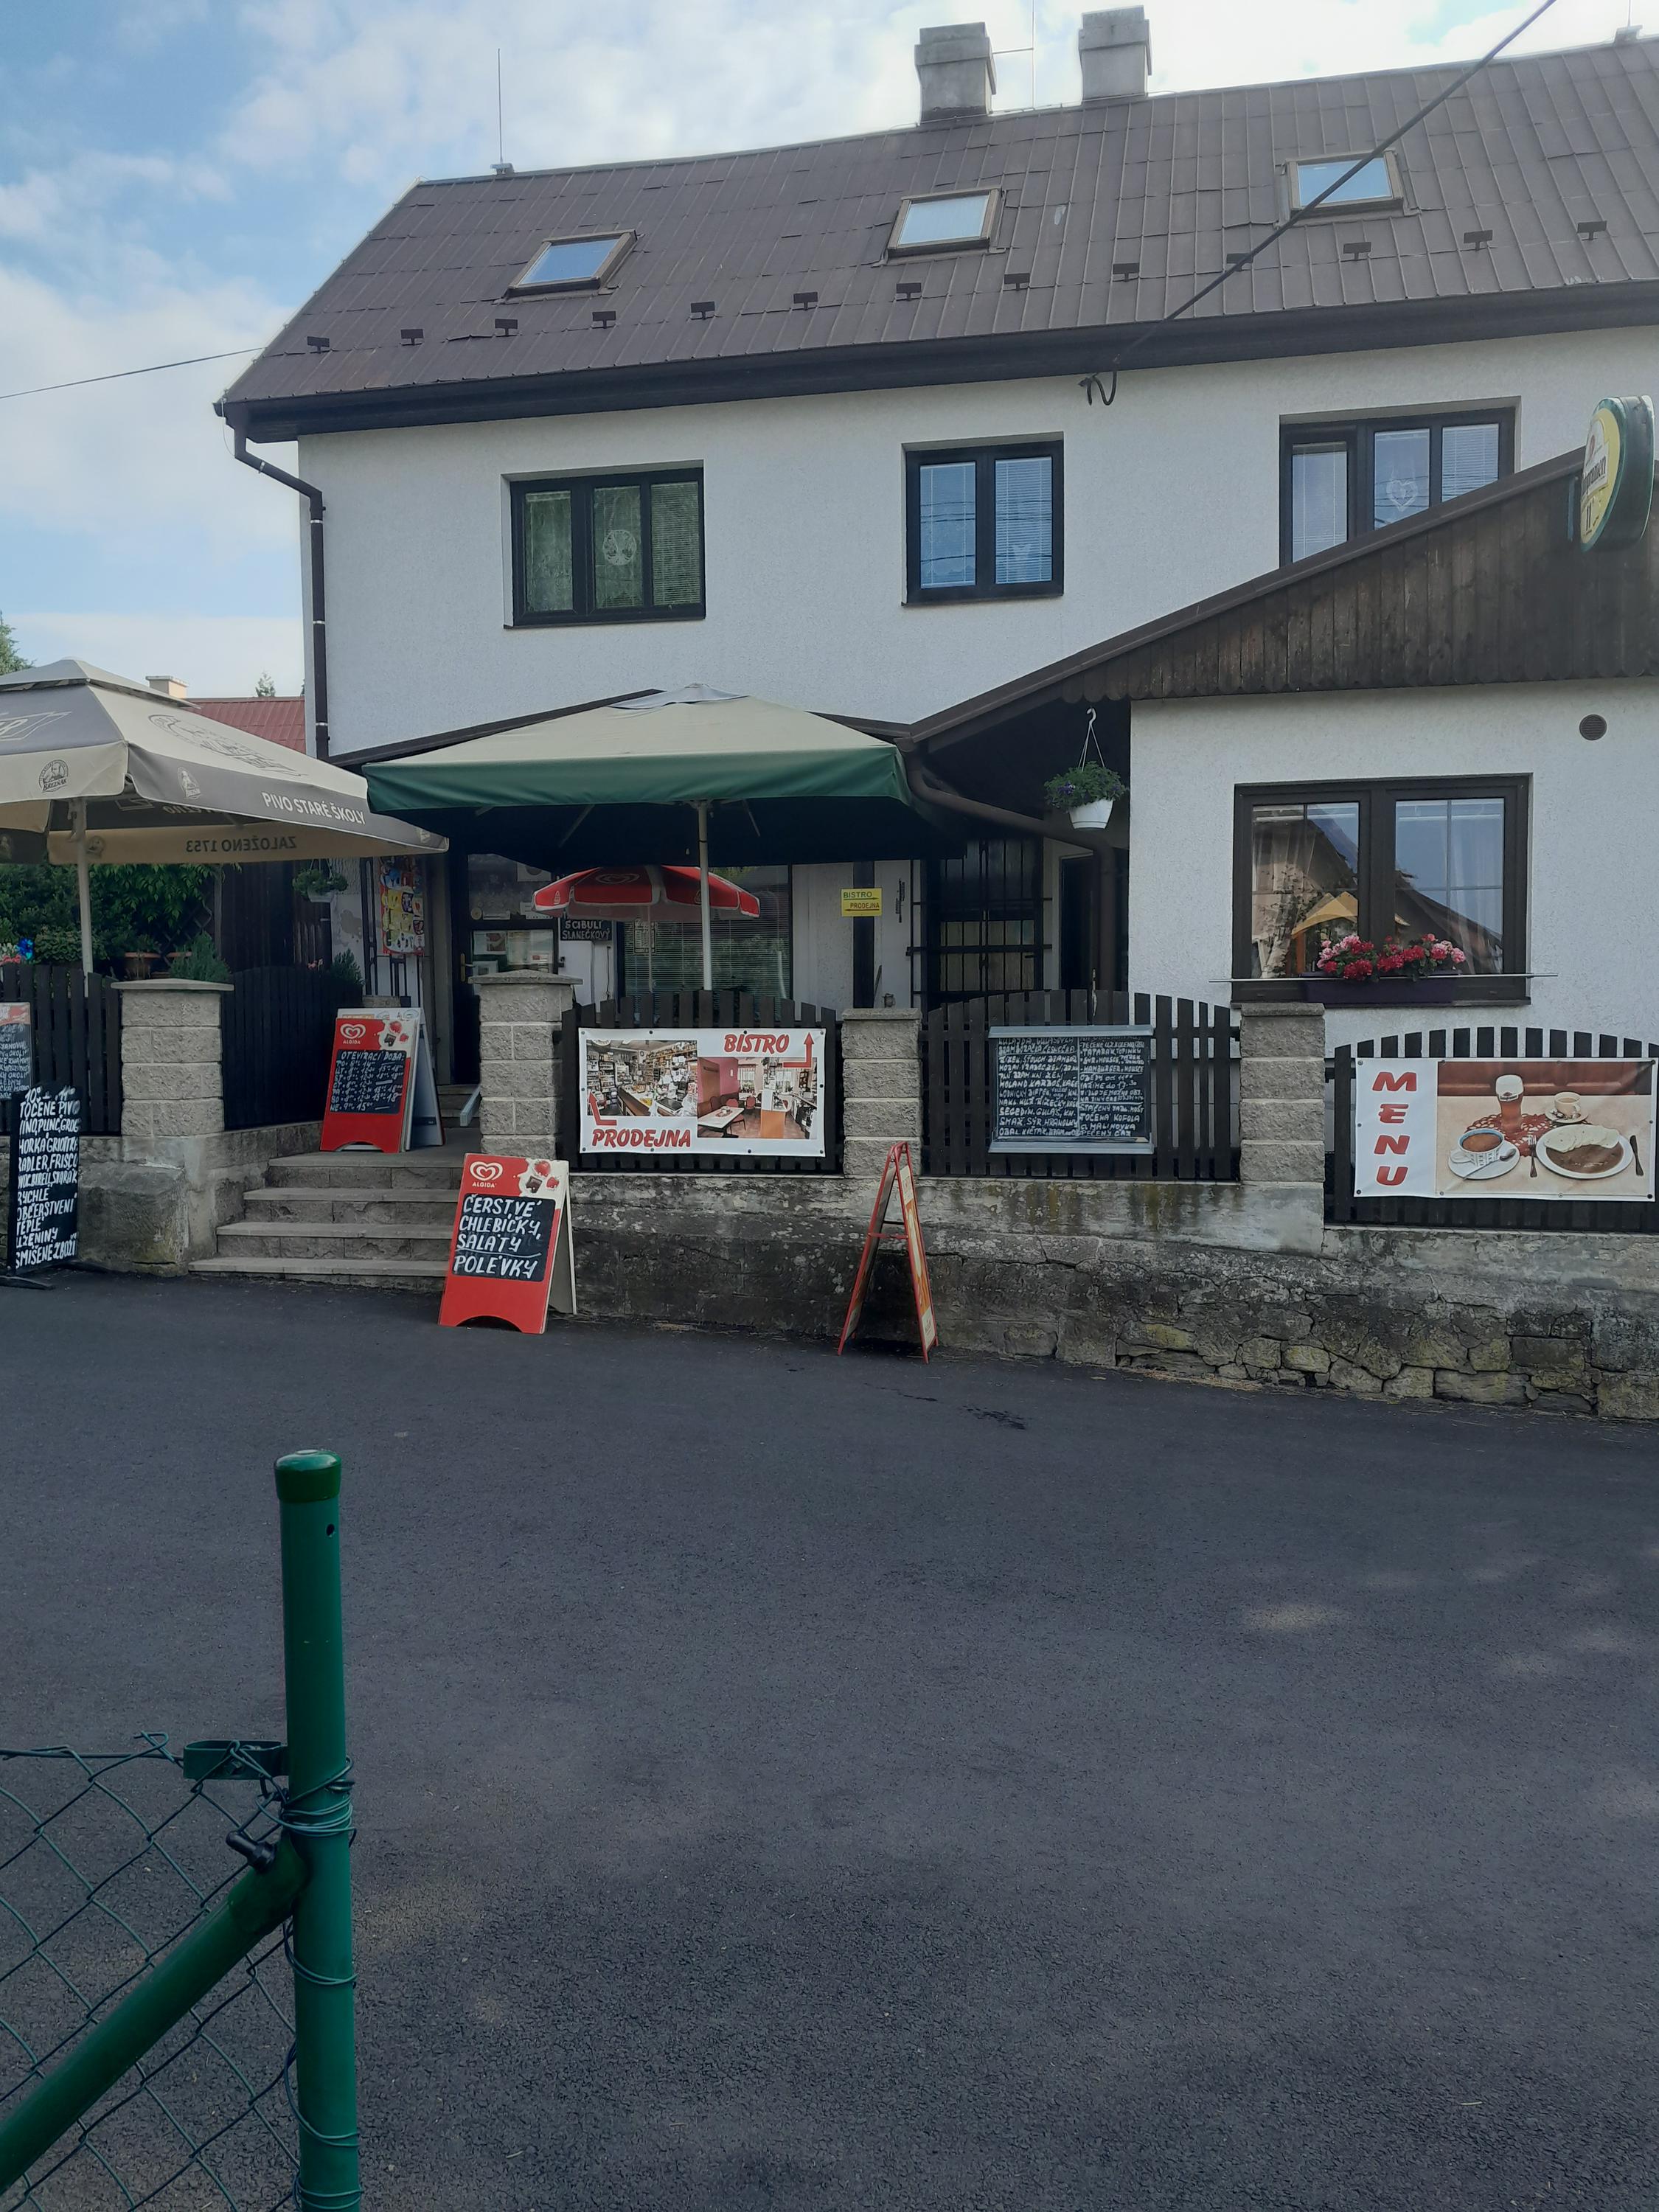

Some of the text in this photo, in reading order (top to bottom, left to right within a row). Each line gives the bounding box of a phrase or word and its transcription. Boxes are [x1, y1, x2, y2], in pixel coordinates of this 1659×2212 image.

[261, 792, 366, 825] PIVO STARÉ ŠKOLY
[723, 1034, 790, 1054] BISTRO
[592, 1129, 692, 1148] PRODEJNA
[1371, 1071, 1418, 1186] MENU
[463, 1193, 543, 1217] ČERSTVÉ
[456, 1232, 522, 1252] SALÁTY
[453, 1254, 538, 1279] POLÉVKY
